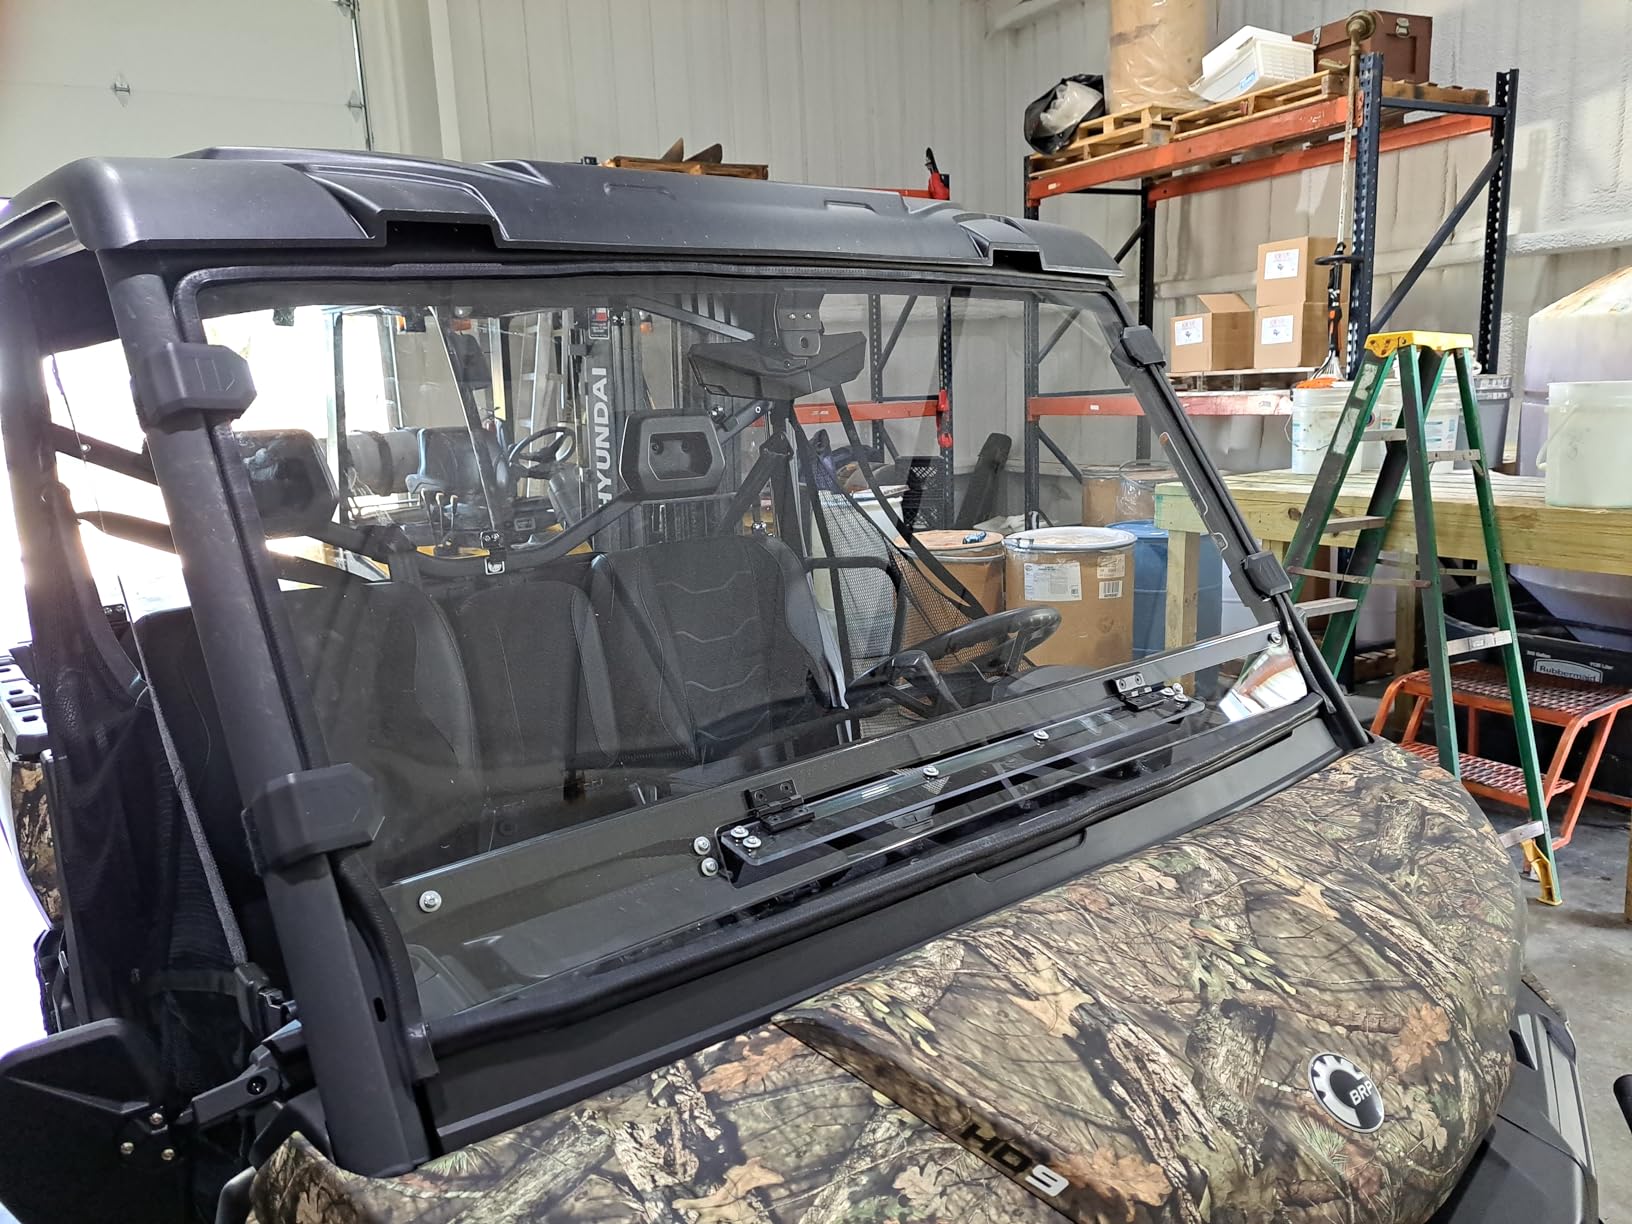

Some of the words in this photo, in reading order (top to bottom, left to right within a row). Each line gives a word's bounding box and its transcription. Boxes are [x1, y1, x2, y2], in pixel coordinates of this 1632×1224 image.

[592, 368, 612, 508] HYUNDAI
[1540, 665, 1597, 682] Rubbermaid
[1349, 1080, 1373, 1106] BRP
[960, 1122, 1069, 1197] HD9
